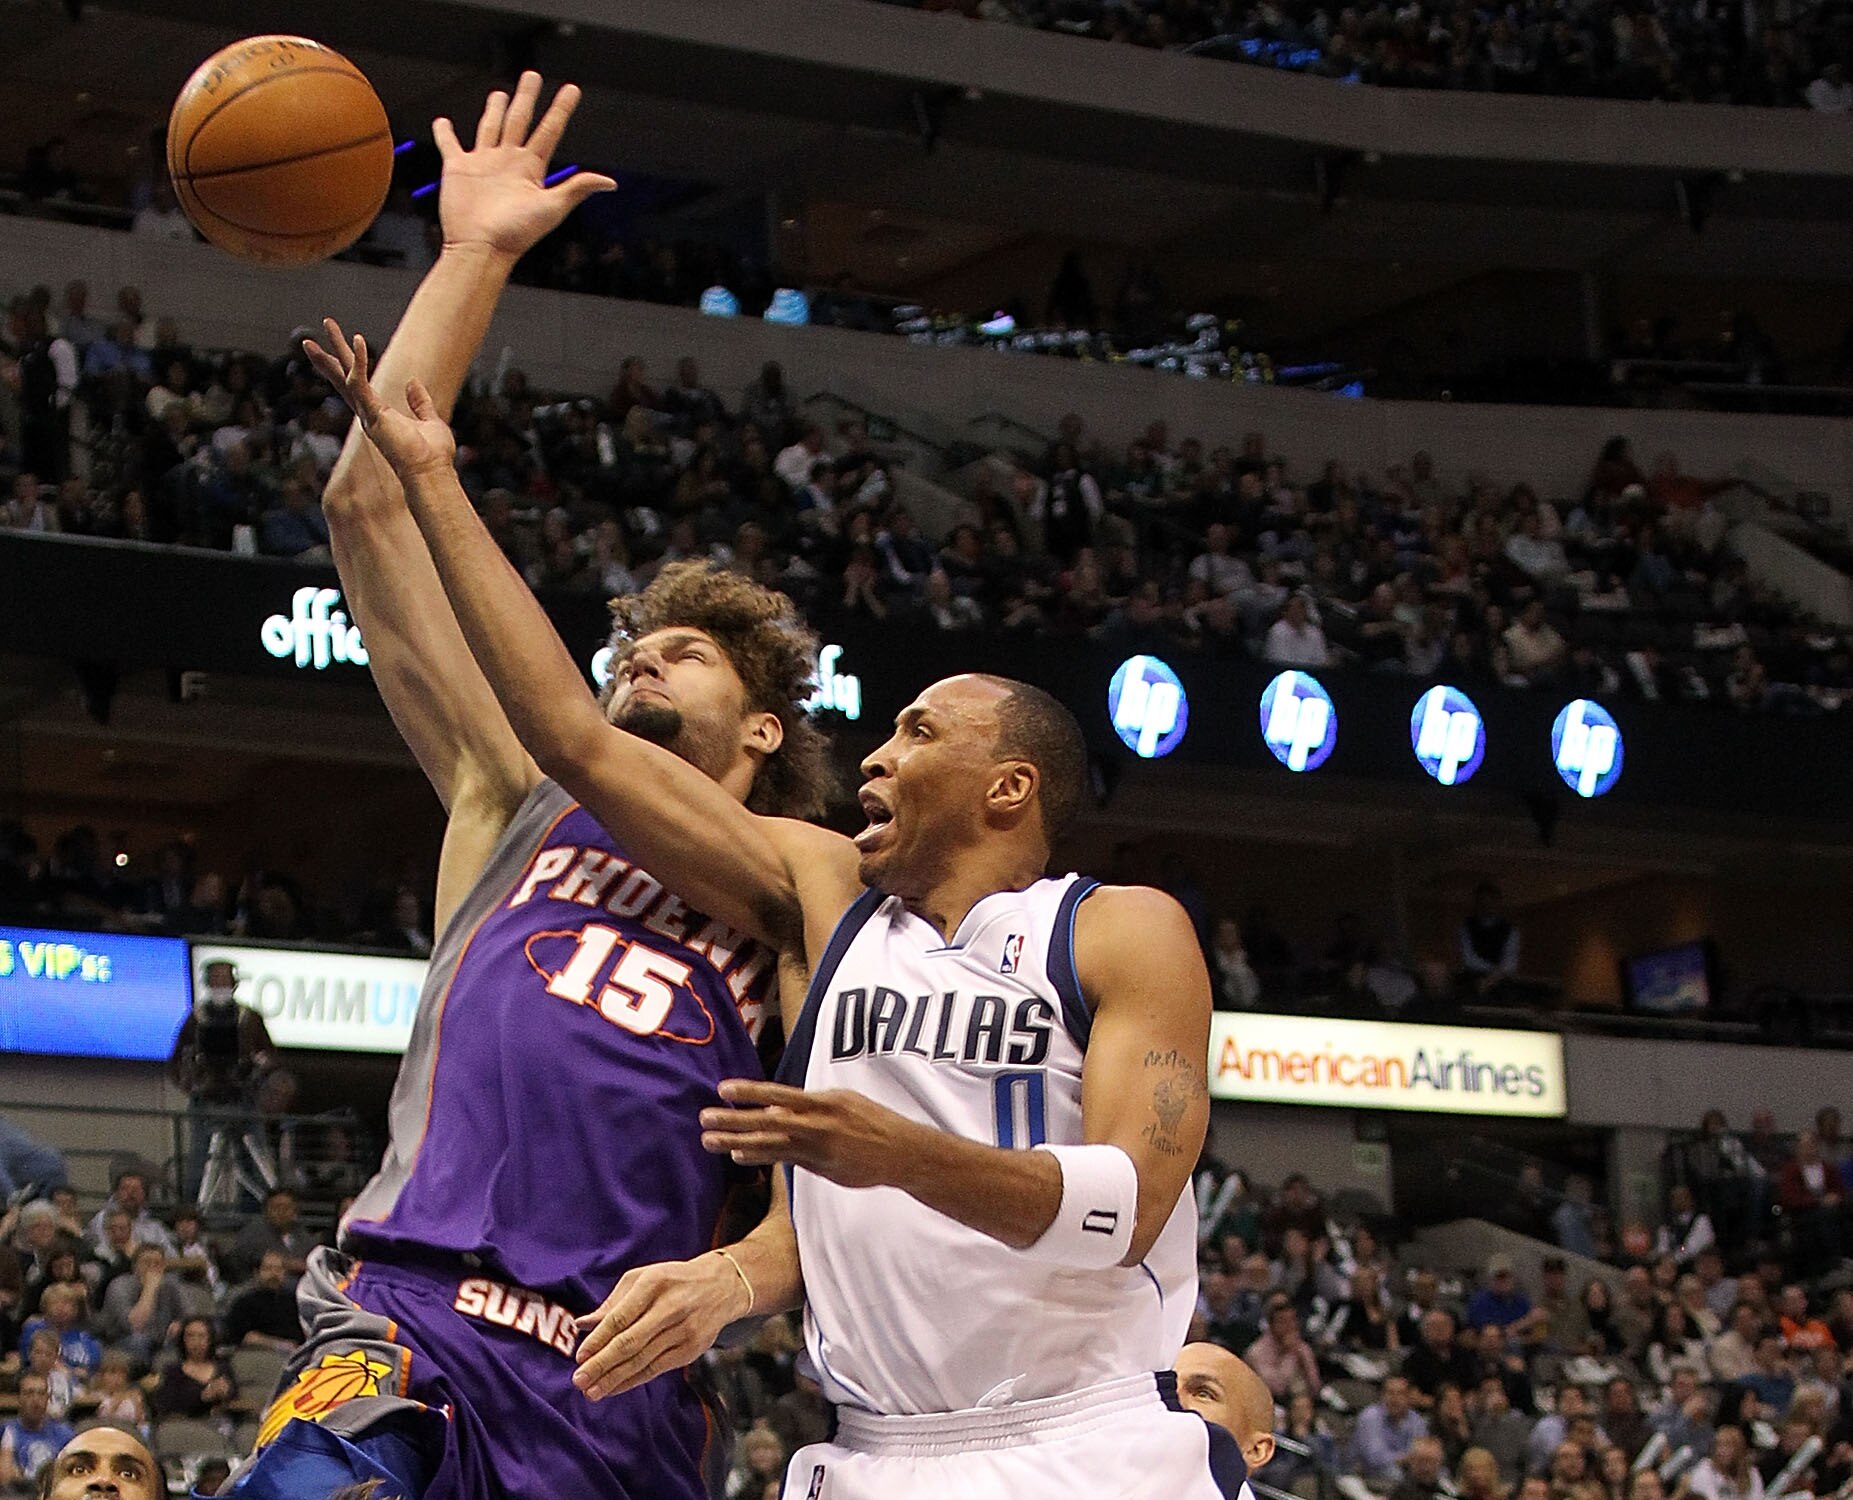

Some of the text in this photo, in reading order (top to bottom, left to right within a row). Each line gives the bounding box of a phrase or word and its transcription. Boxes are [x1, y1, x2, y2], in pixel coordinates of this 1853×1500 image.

[1112, 655, 1181, 758] hp
[1265, 670, 1330, 772] hp
[1415, 685, 1478, 785] hp
[1556, 699, 1617, 798] hp
[545, 922, 694, 1036] 15
[830, 985, 1055, 1066] DALLAS
[453, 1277, 579, 1358] SUNS
